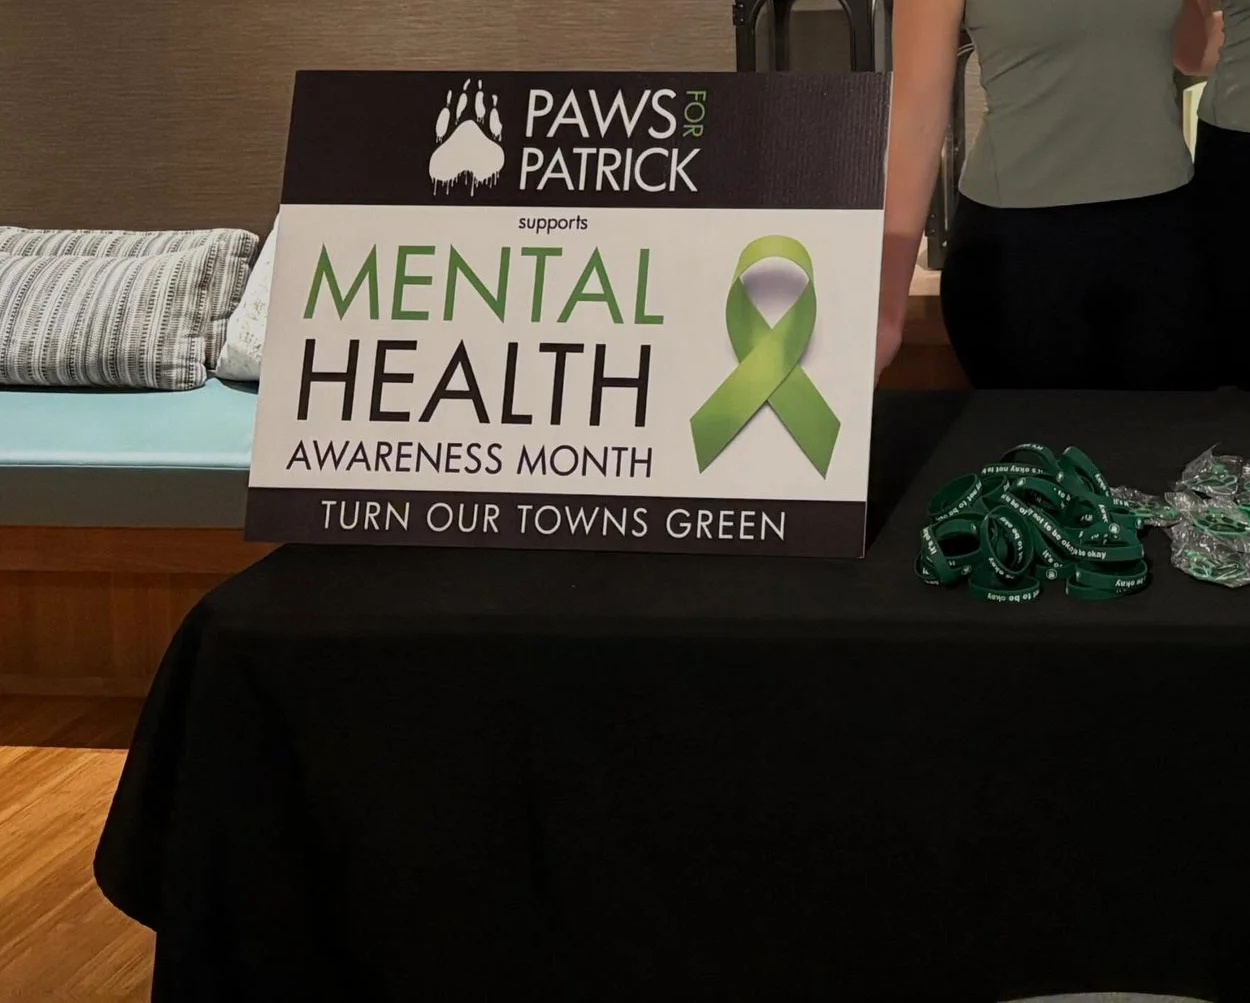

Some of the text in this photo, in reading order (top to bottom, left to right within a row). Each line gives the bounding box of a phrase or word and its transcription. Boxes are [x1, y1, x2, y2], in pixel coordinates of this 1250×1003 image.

[526, 89, 677, 139] PAWS
[682, 90, 706, 137] FOR
[519, 147, 701, 192] PATRICK
[518, 215, 588, 234] supports
[303, 244, 664, 325] MENTAL
[296, 338, 652, 428] HEALTH
[286, 440, 652, 478] AWARENESS MONTH
[322, 501, 786, 540] TURN OUR TOWNS GREEN
[1087, 550, 1106, 560] okay
[1115, 579, 1135, 588] okay
